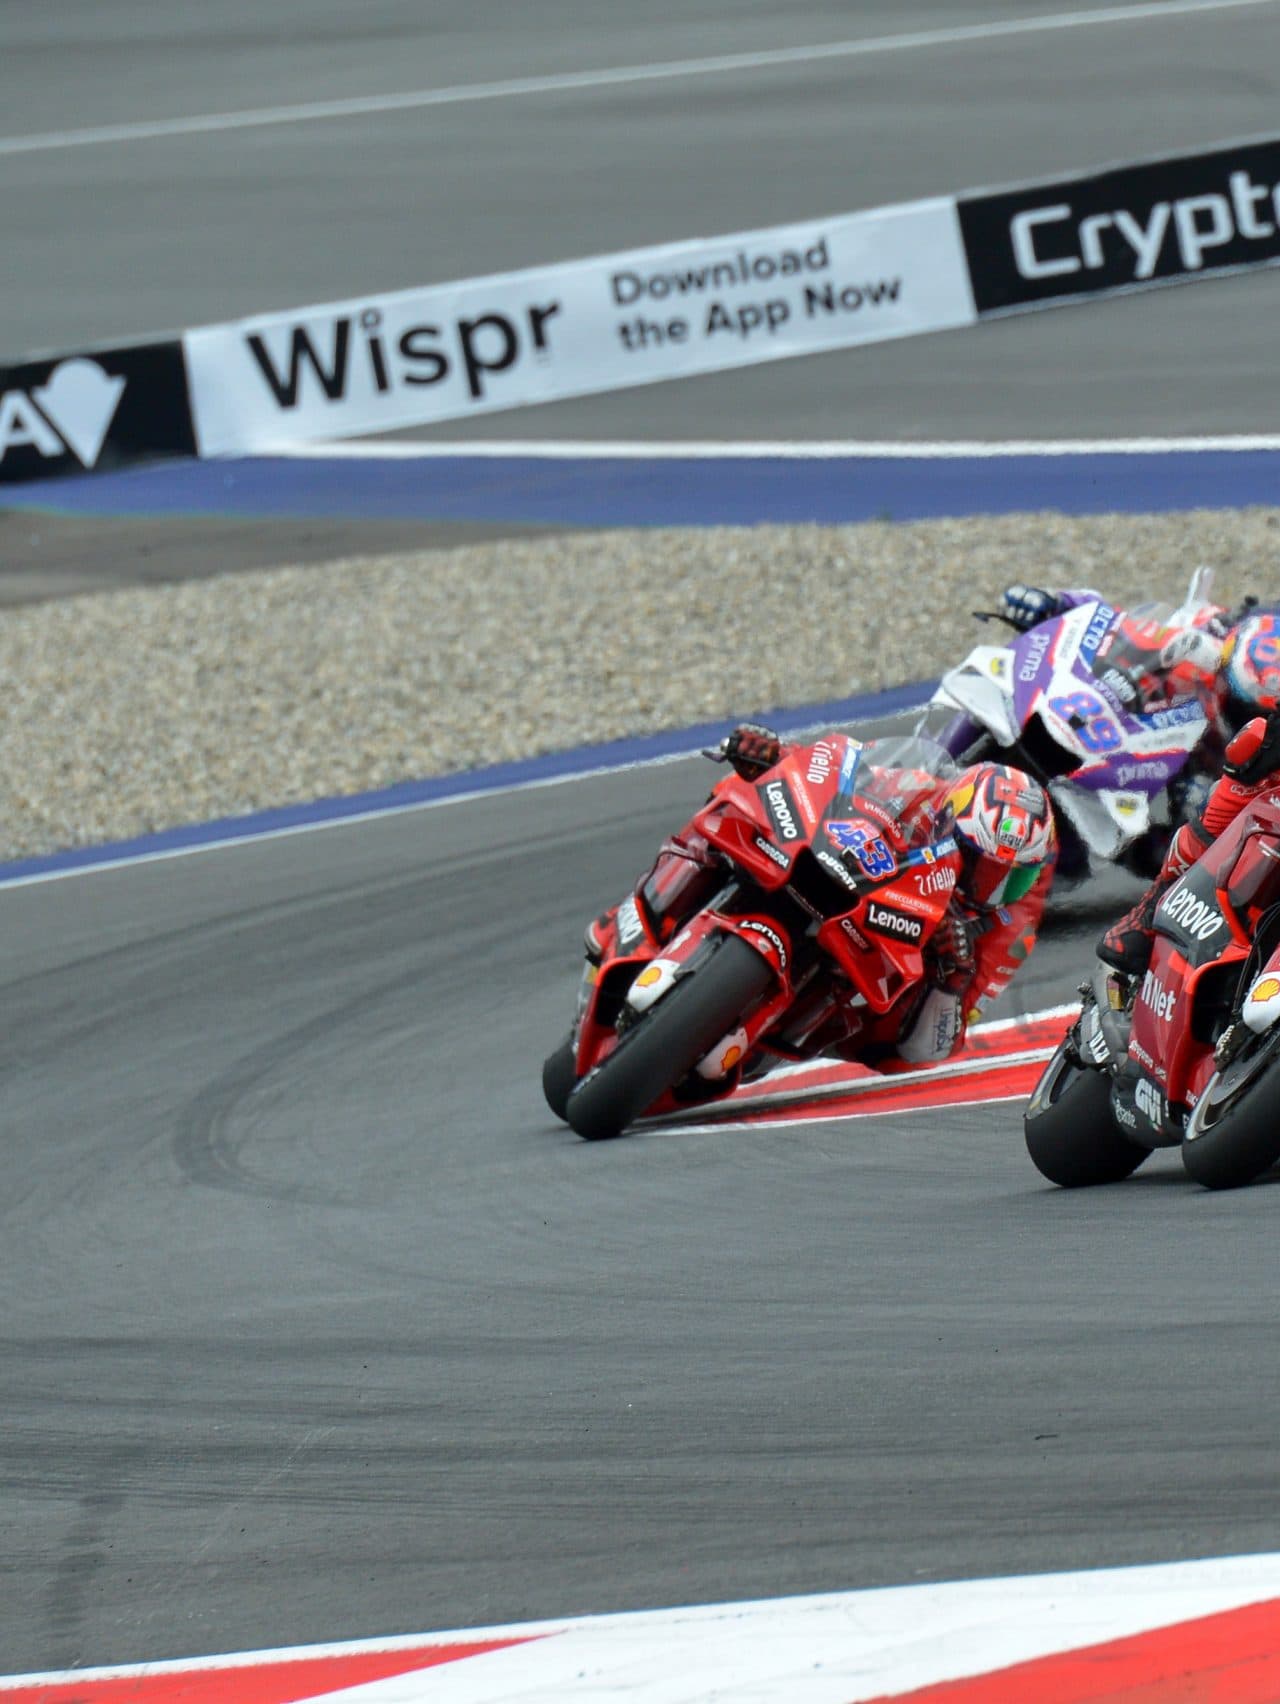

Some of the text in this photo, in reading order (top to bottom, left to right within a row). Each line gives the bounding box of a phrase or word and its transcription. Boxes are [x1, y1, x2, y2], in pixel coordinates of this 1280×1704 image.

[609, 237, 830, 307] Download
[617, 274, 903, 353] the App Now
[246, 298, 562, 413] Wispr
[1049, 692, 1124, 753] 89
[766, 781, 798, 839] Lenovo
[817, 851, 857, 890] DUCATI
[824, 818, 898, 882] 43
[869, 904, 921, 937] Lenovo
[1161, 875, 1224, 940] Lenovo
[740, 920, 786, 968] Lenovo
